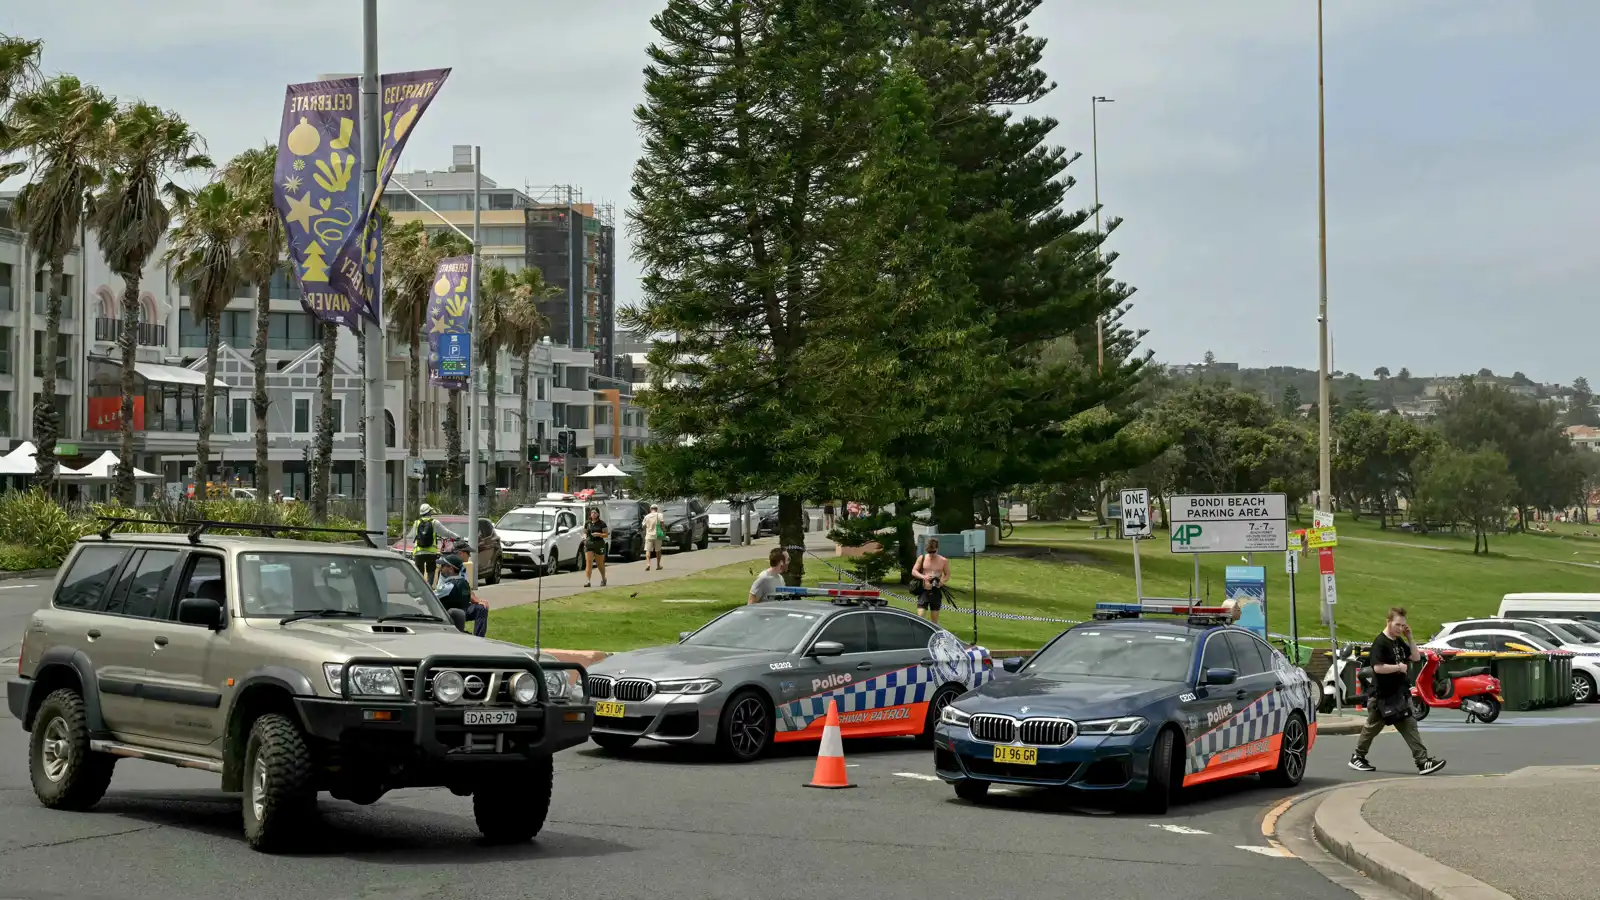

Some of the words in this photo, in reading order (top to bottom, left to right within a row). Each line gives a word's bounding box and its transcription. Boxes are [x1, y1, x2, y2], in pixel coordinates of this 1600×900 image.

[384, 80, 438, 105] CELEBRAT
[1125, 493, 1145, 505] ONE
[1190, 498, 1224, 507] BONDI
[1227, 497, 1266, 507] BEACH
[1124, 507, 1147, 520] WAY
[1187, 509, 1235, 518] PARKING
[1238, 508, 1270, 517] AREA
[1171, 524, 1203, 546] 4P
[769, 661, 793, 671] CE202
[812, 672, 853, 692] Police
[838, 711, 869, 724] GHWAY
[869, 707, 911, 721] PATROL
[1206, 702, 1234, 728] Police
[995, 747, 1006, 759] DI
[1009, 748, 1021, 761] 96
[1023, 749, 1036, 762] GR
